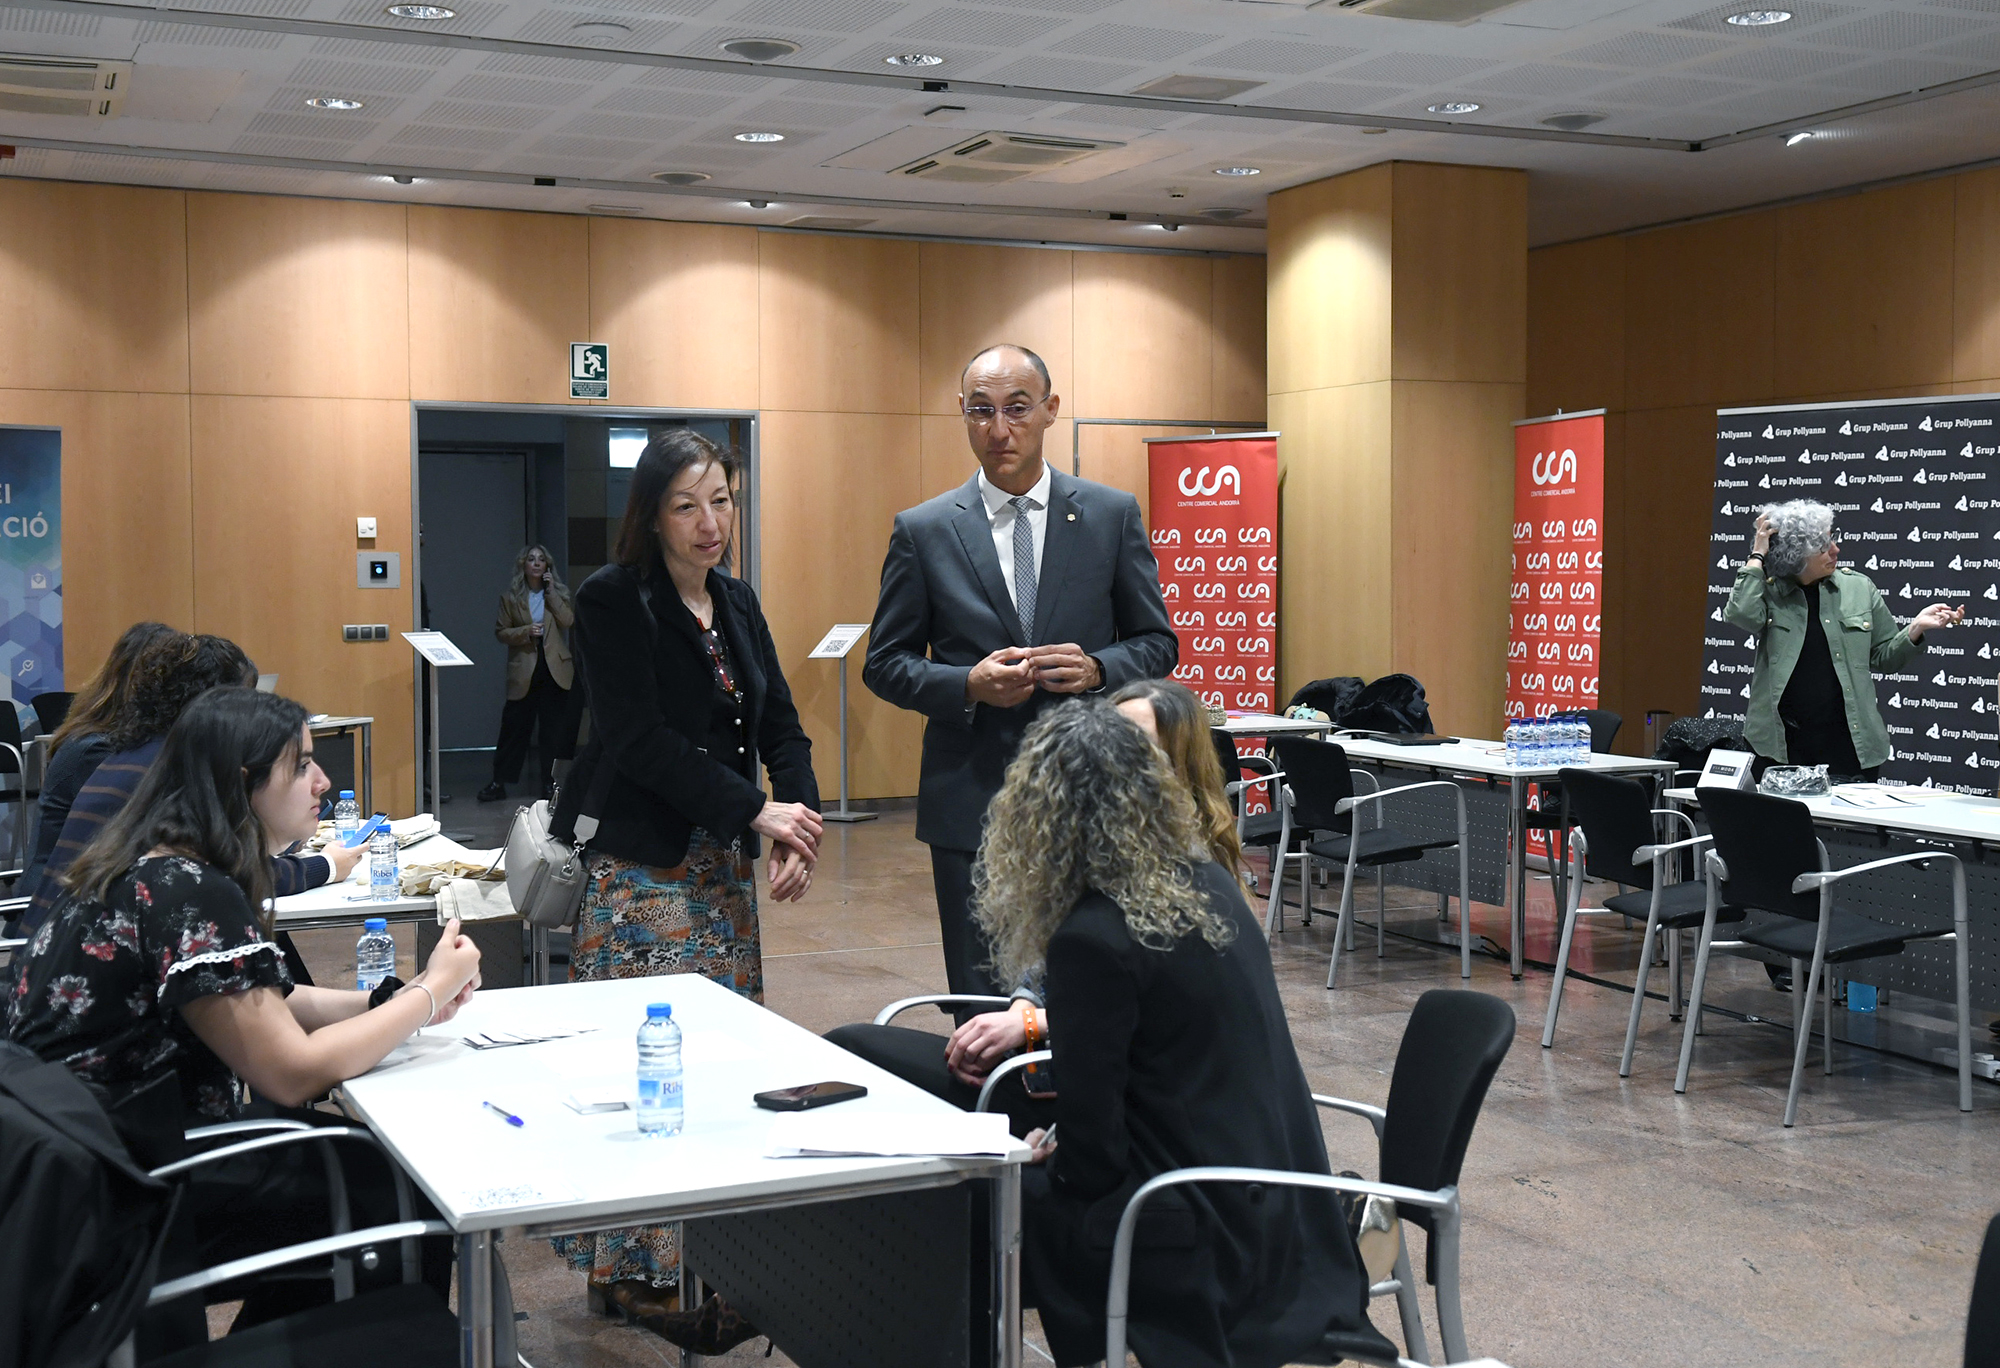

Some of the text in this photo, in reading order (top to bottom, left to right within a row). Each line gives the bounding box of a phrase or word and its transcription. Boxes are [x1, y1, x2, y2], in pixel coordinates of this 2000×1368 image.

[1854, 423, 1908, 433] Grup Pollyanna
[1935, 418, 1992, 429] Grup Pollyanna
[1721, 431, 1752, 440] Pollyanna
[1776, 427, 1826, 437] Grup Pollyanna
[1890, 448, 1946, 459] Grup Pollyanna
[1976, 446, 1995, 455] Grup
[1737, 455, 1786, 465] Grup Pollyanna
[1812, 452, 1864, 462] Grup Pollyanna
[1533, 449, 1577, 485] CCA
[1178, 465, 1240, 497] CCA
[1772, 477, 1821, 486] Grup Pollyanna
[1849, 475, 1903, 484] Grup Pollyanna
[1928, 472, 1986, 482] Grup Pollyanna
[1718, 479, 1748, 489] Pollyanna
[1734, 505, 1749, 514] Grup
[1886, 501, 1940, 511] Grup Pollyanna
[1970, 500, 1988, 509] Grup
[0, 511, 48, 538] CIÓ
[1542, 520, 1564, 538] CCA
[1572, 518, 1597, 536] CCA
[1152, 529, 1180, 544] CCA
[1195, 528, 1226, 543] CCA
[1238, 527, 1270, 543] CCA
[1714, 534, 1744, 542] Pollyanna
[1844, 532, 1897, 541] Grup Pollyanna
[1922, 531, 1979, 541] Grup Pollyanna
[1175, 556, 1205, 571] CCA
[1216, 556, 1247, 571] CCA
[1526, 552, 1550, 569] CCA
[1557, 551, 1578, 569] CCA
[1880, 559, 1934, 568] Grup Pollyanna
[1964, 560, 1981, 569] Grup
[1194, 583, 1225, 598] CCA
[1238, 583, 1270, 598] CCA
[1540, 582, 1562, 599] CCA
[1570, 582, 1595, 599] CCA
[1914, 588, 1970, 598] Grup Pollyanna
[1174, 611, 1204, 626] CCA
[1216, 611, 1246, 627] CCA
[1524, 613, 1547, 631] CCA
[1555, 614, 1575, 631] CCA
[1960, 619, 1973, 627] rup
[1193, 637, 1224, 652] CCA
[1237, 637, 1269, 652] CCA
[1705, 638, 1734, 647] Pollyanna
[1538, 642, 1560, 660] CCA
[1568, 644, 1593, 661] CCA
[1927, 646, 1964, 656] Pollyanna
[1215, 665, 1246, 680] CCA
[1720, 664, 1735, 673] Grup
[1521, 673, 1545, 690] CCA
[1871, 673, 1883, 681] rup
[1948, 676, 1966, 684] Grup
[1552, 675, 1574, 692] CCA
[1701, 686, 1731, 695] Pollyanna
[1903, 698, 1958, 709] Grup Pollyanna
[1887, 724, 1913, 734] llyanna
[1942, 729, 1998, 740] Grup Pollyanna
[1897, 751, 1951, 762] Grup Pollyanna
[1980, 758, 1999, 768] Grup
[1877, 777, 1907, 786] ollyanna
